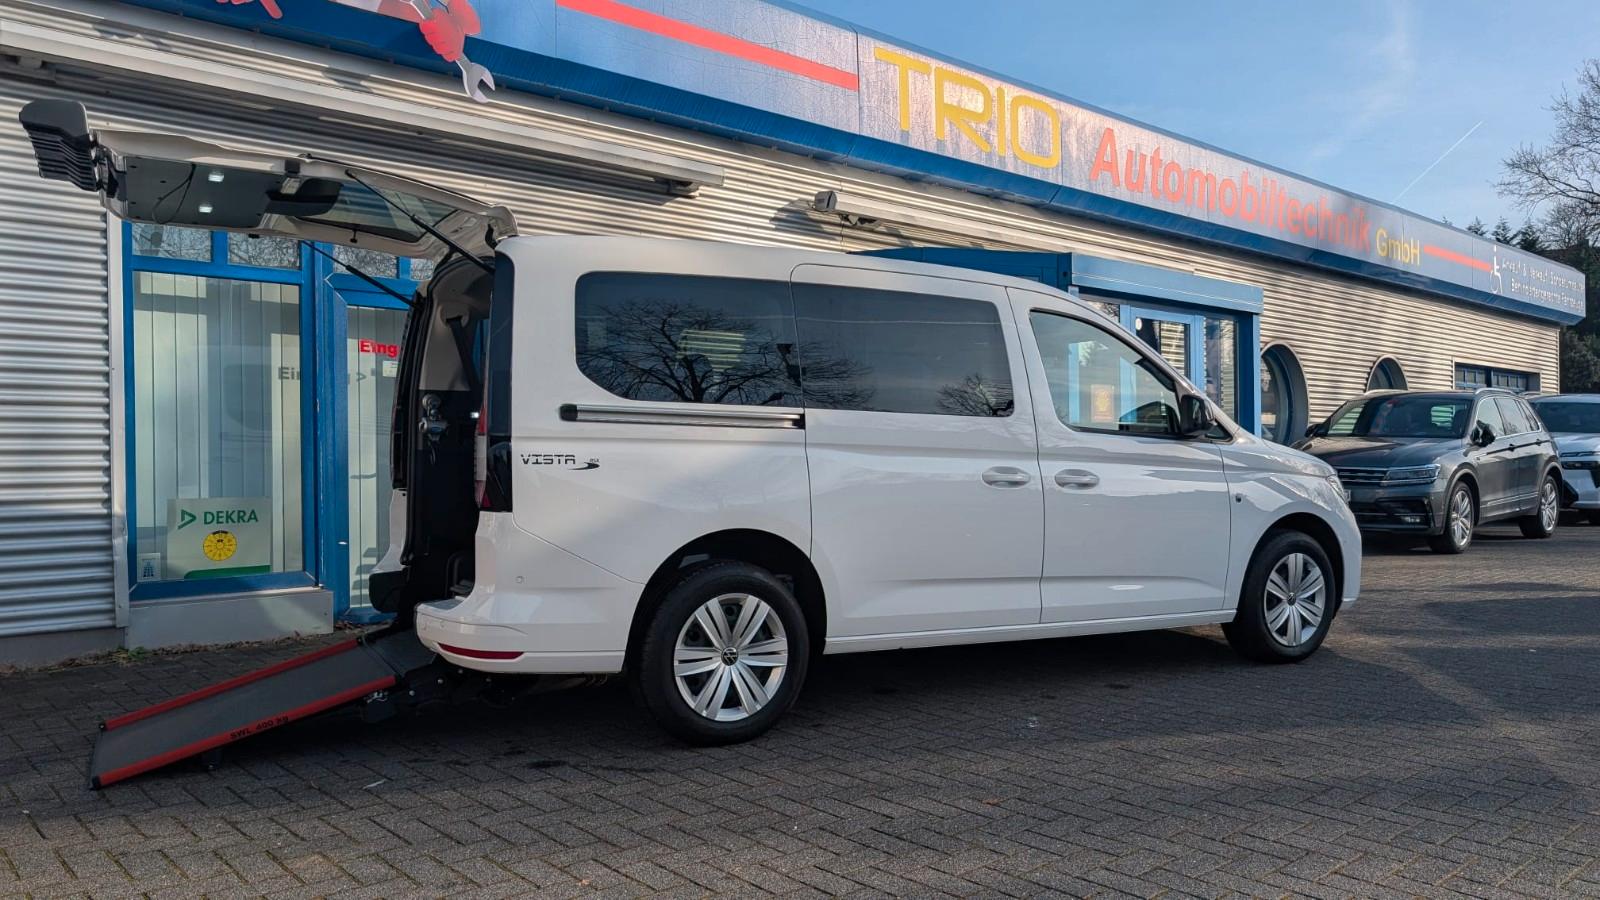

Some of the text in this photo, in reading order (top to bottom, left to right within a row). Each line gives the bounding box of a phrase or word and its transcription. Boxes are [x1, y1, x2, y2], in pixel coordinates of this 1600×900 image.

[874, 47, 1420, 265] TRIO Automobiltechnik GmbH
[520, 453, 576, 465] VISTA
[203, 509, 259, 525] DEKRA
